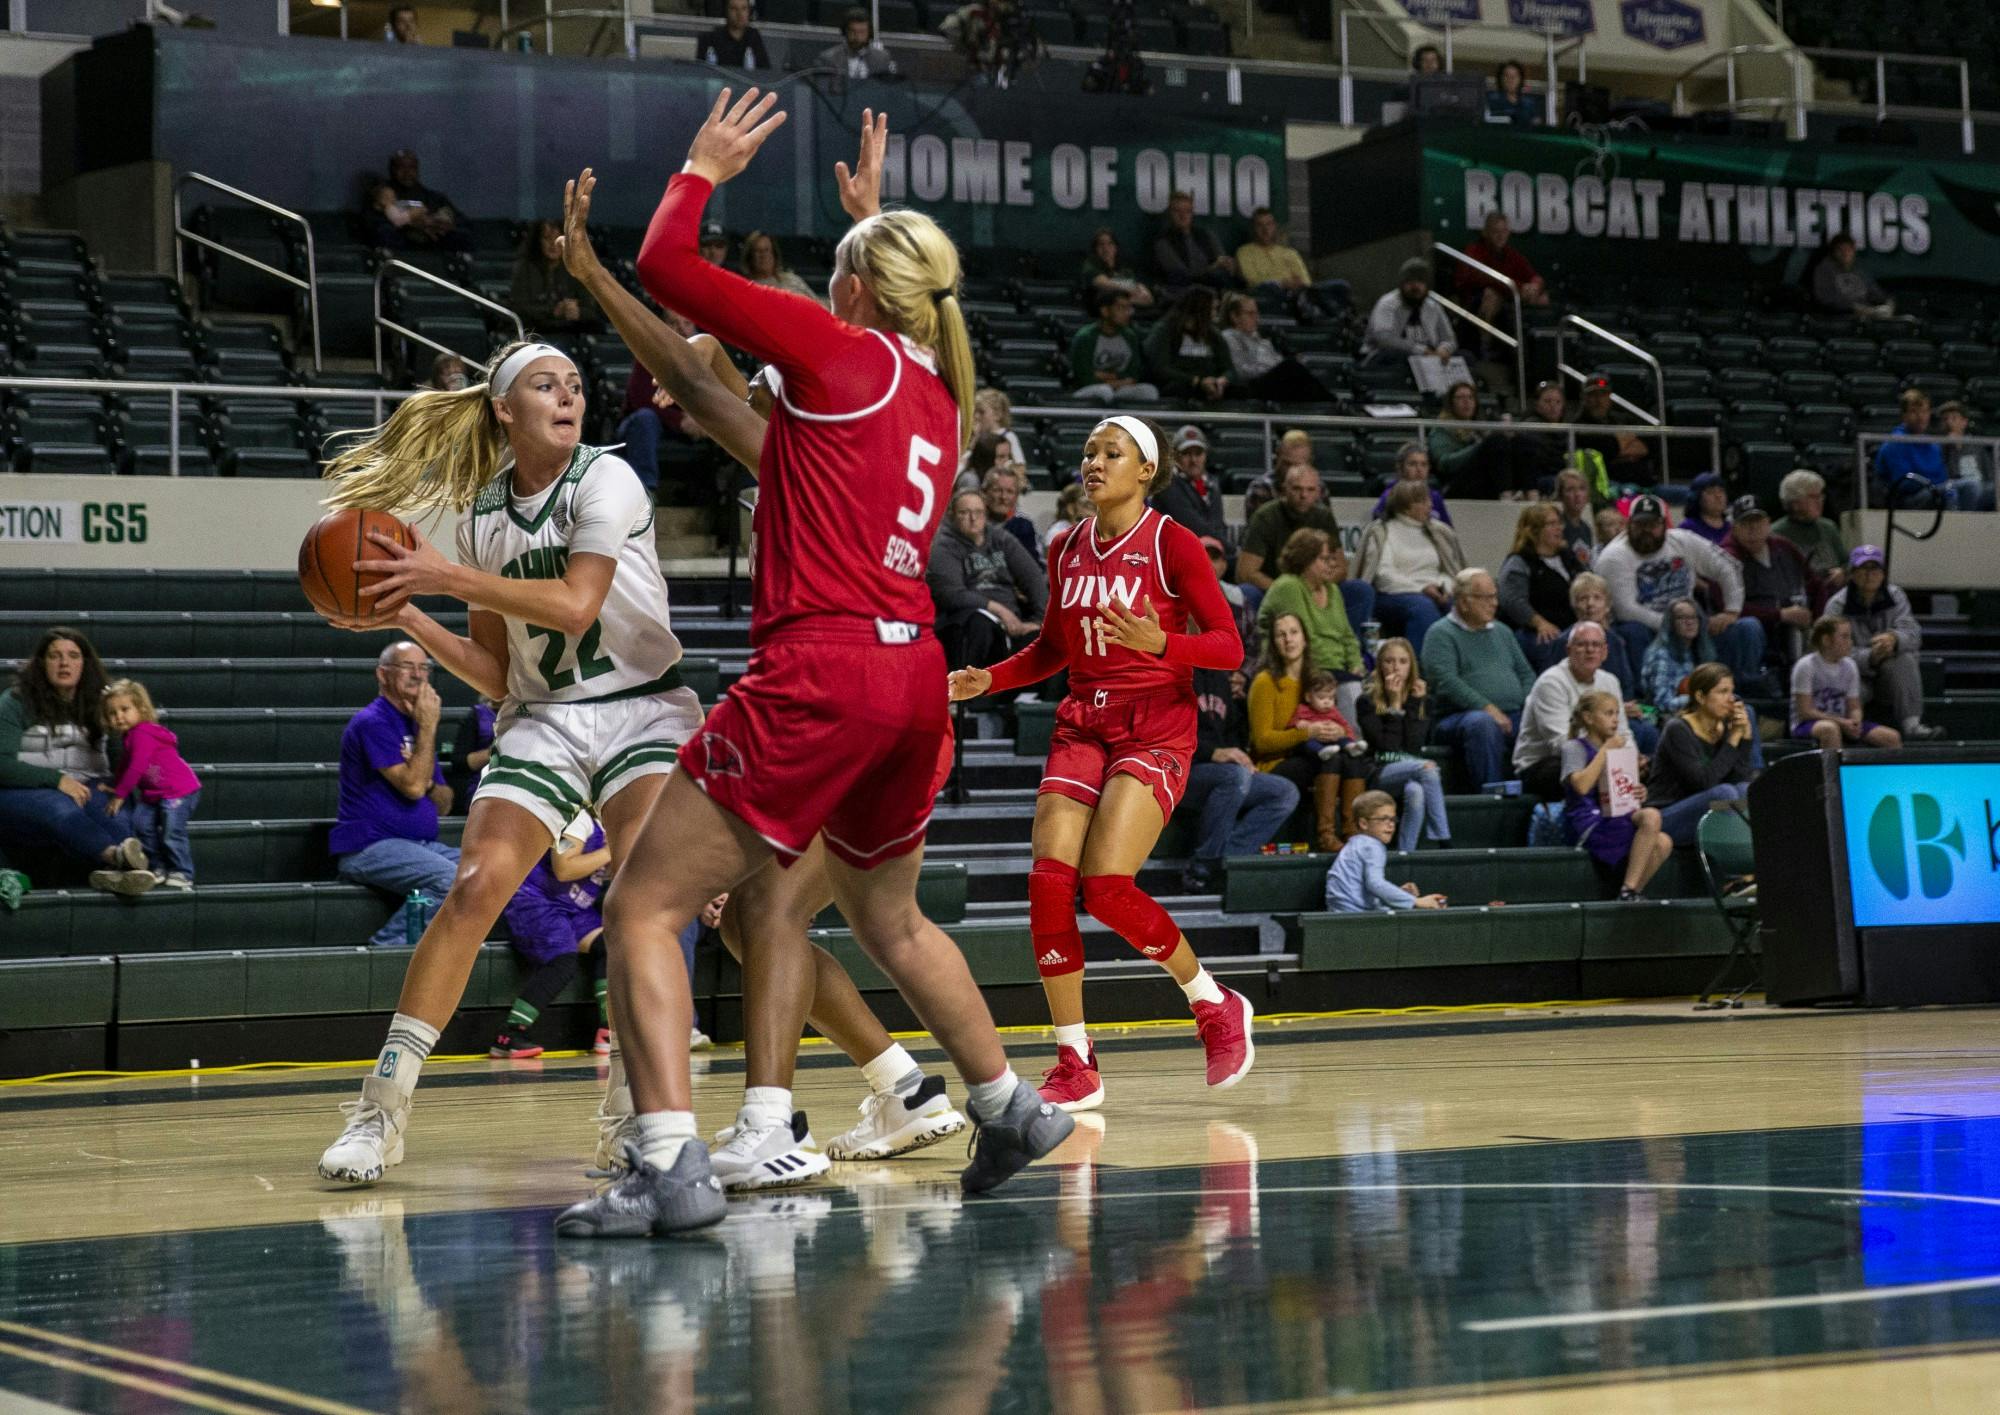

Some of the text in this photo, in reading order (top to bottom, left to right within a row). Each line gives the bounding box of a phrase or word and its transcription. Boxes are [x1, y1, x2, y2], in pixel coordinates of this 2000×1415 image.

[1050, 143, 1118, 210] OF
[1135, 148, 1270, 219] OHIO
[1464, 168, 1931, 255] BOBCAT ATHLETICS
[897, 434, 942, 533] 5
[82, 502, 148, 543] CS5
[1061, 575, 1142, 610] UIW
[526, 617, 617, 692] 22
